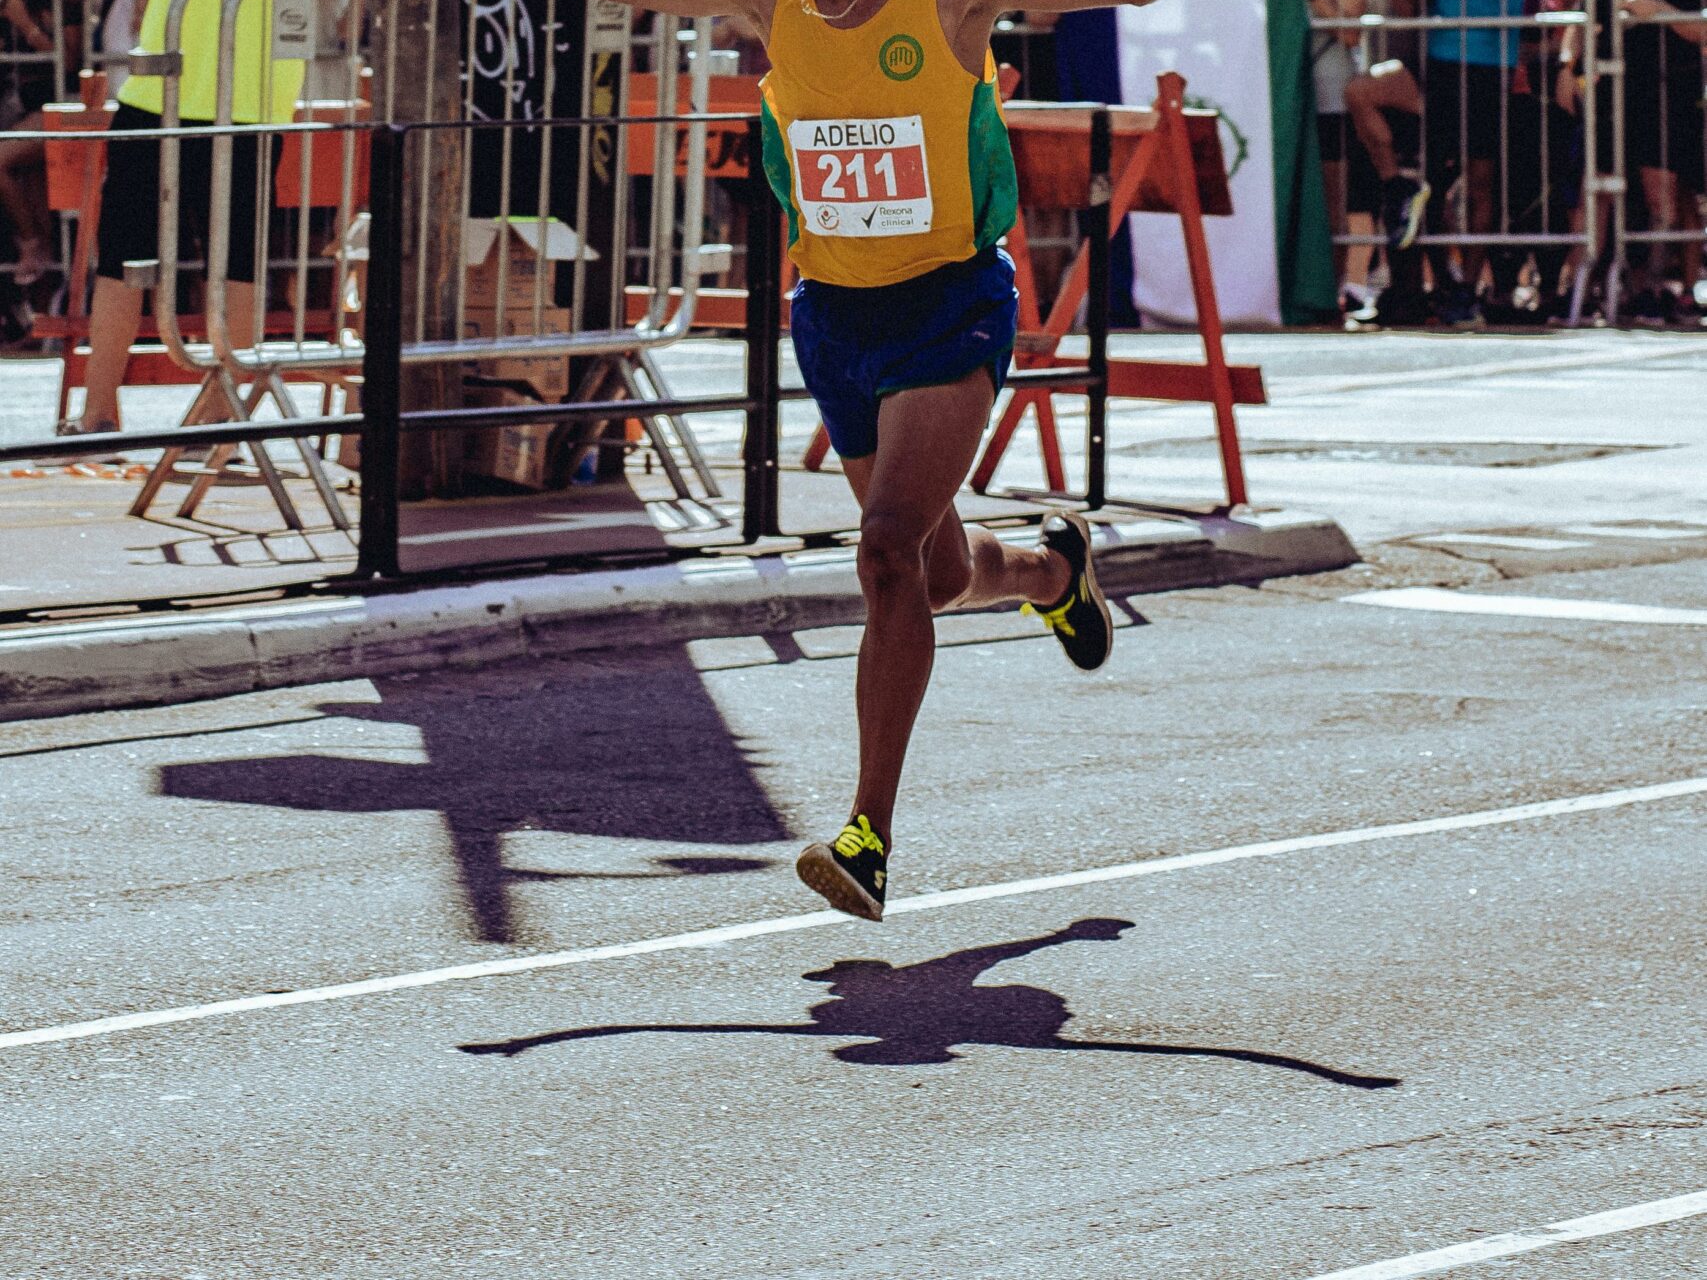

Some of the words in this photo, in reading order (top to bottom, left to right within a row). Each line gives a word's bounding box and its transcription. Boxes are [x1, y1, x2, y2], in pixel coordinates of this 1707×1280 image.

[813, 123, 895, 147] ADELIO
[816, 152, 898, 199] 211
[879, 207, 913, 216] Rexona
[881, 218, 915, 227] clinical
